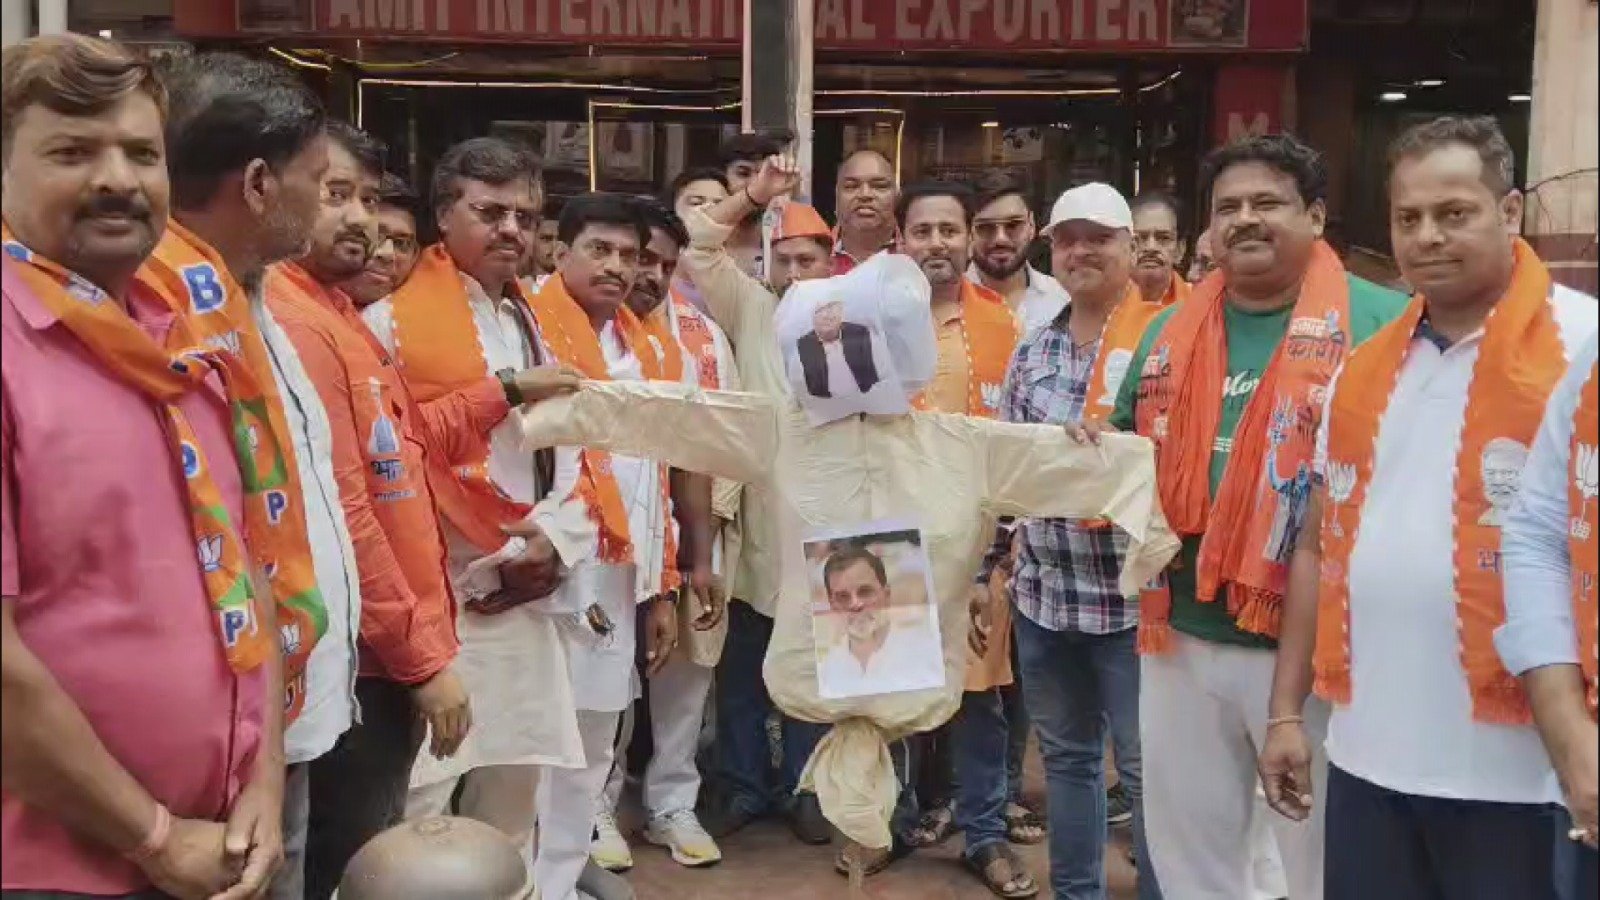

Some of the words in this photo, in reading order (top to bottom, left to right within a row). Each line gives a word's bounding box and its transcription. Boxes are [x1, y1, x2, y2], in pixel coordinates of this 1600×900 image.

[329, 0, 449, 31] AMIT
[895, 0, 1158, 42] EXPORTER
[181, 262, 226, 313] B
[264, 489, 288, 524] P
